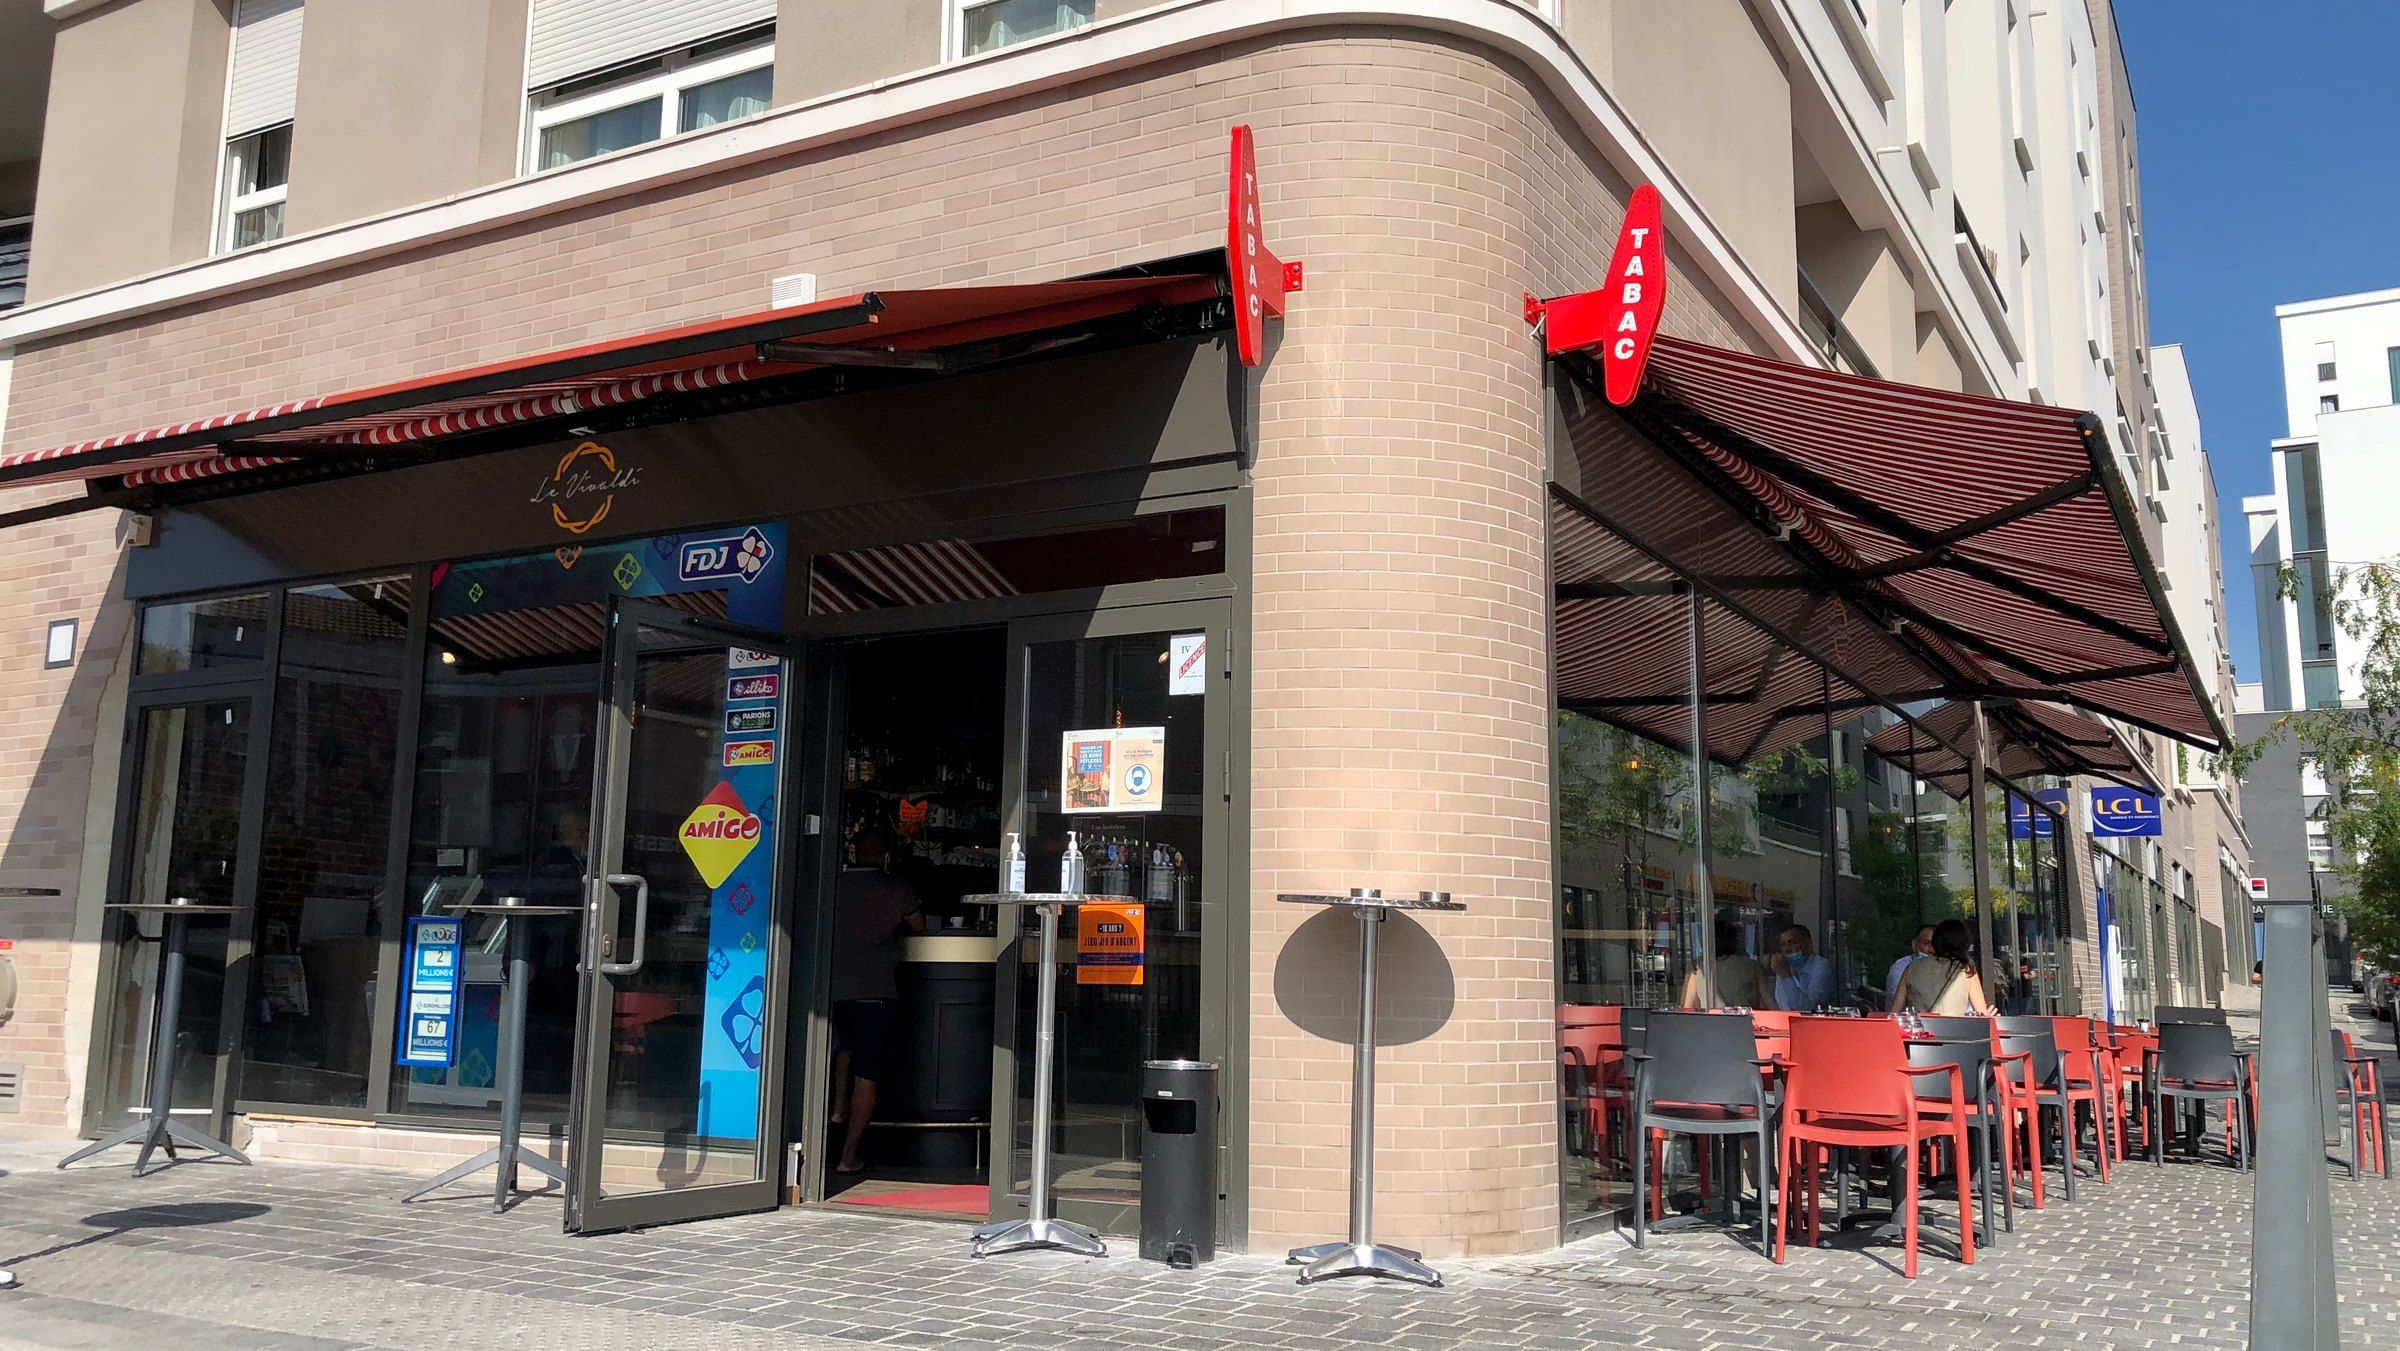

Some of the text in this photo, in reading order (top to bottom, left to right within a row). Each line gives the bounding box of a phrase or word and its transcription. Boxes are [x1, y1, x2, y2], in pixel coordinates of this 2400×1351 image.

[1245, 172, 1260, 317] TABAC
[1614, 227, 1649, 360] TABAC
[530, 468, 643, 503] Le Vivaldi
[685, 546, 729, 573] FDJ
[1181, 645, 1192, 654] IV
[743, 680, 774, 695] illiko
[742, 711, 771, 720] PARIONS
[2097, 798, 2152, 815] LCL
[437, 950, 444, 963] 2
[419, 969, 449, 977] MILLIONS
[427, 1021, 440, 1034] 67
[413, 1038, 443, 1047] MILLIONS
